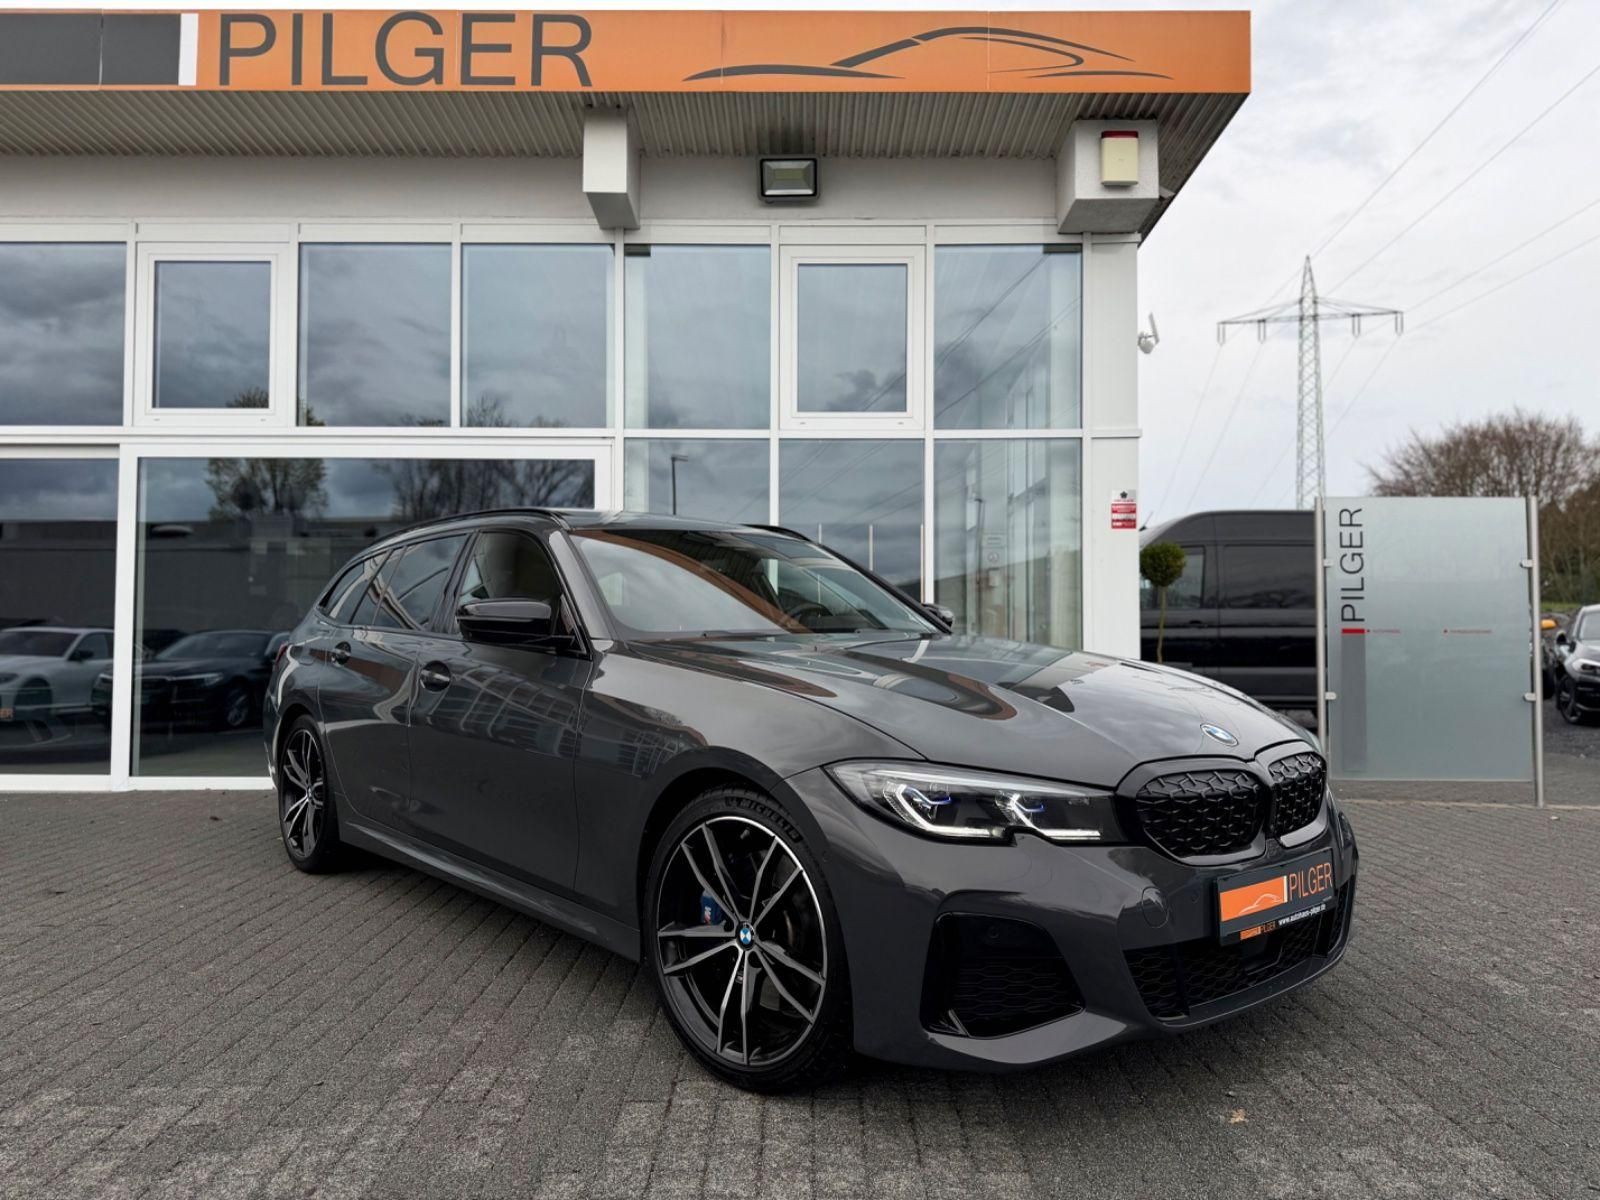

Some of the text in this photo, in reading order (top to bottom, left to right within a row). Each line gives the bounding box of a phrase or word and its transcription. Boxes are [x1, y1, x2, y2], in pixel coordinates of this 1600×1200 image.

[219, 11, 592, 87] PILGER
[1339, 507, 1365, 622] PILGER
[739, 798, 800, 839] MICHELIN
[1288, 862, 1333, 901] PILGER
